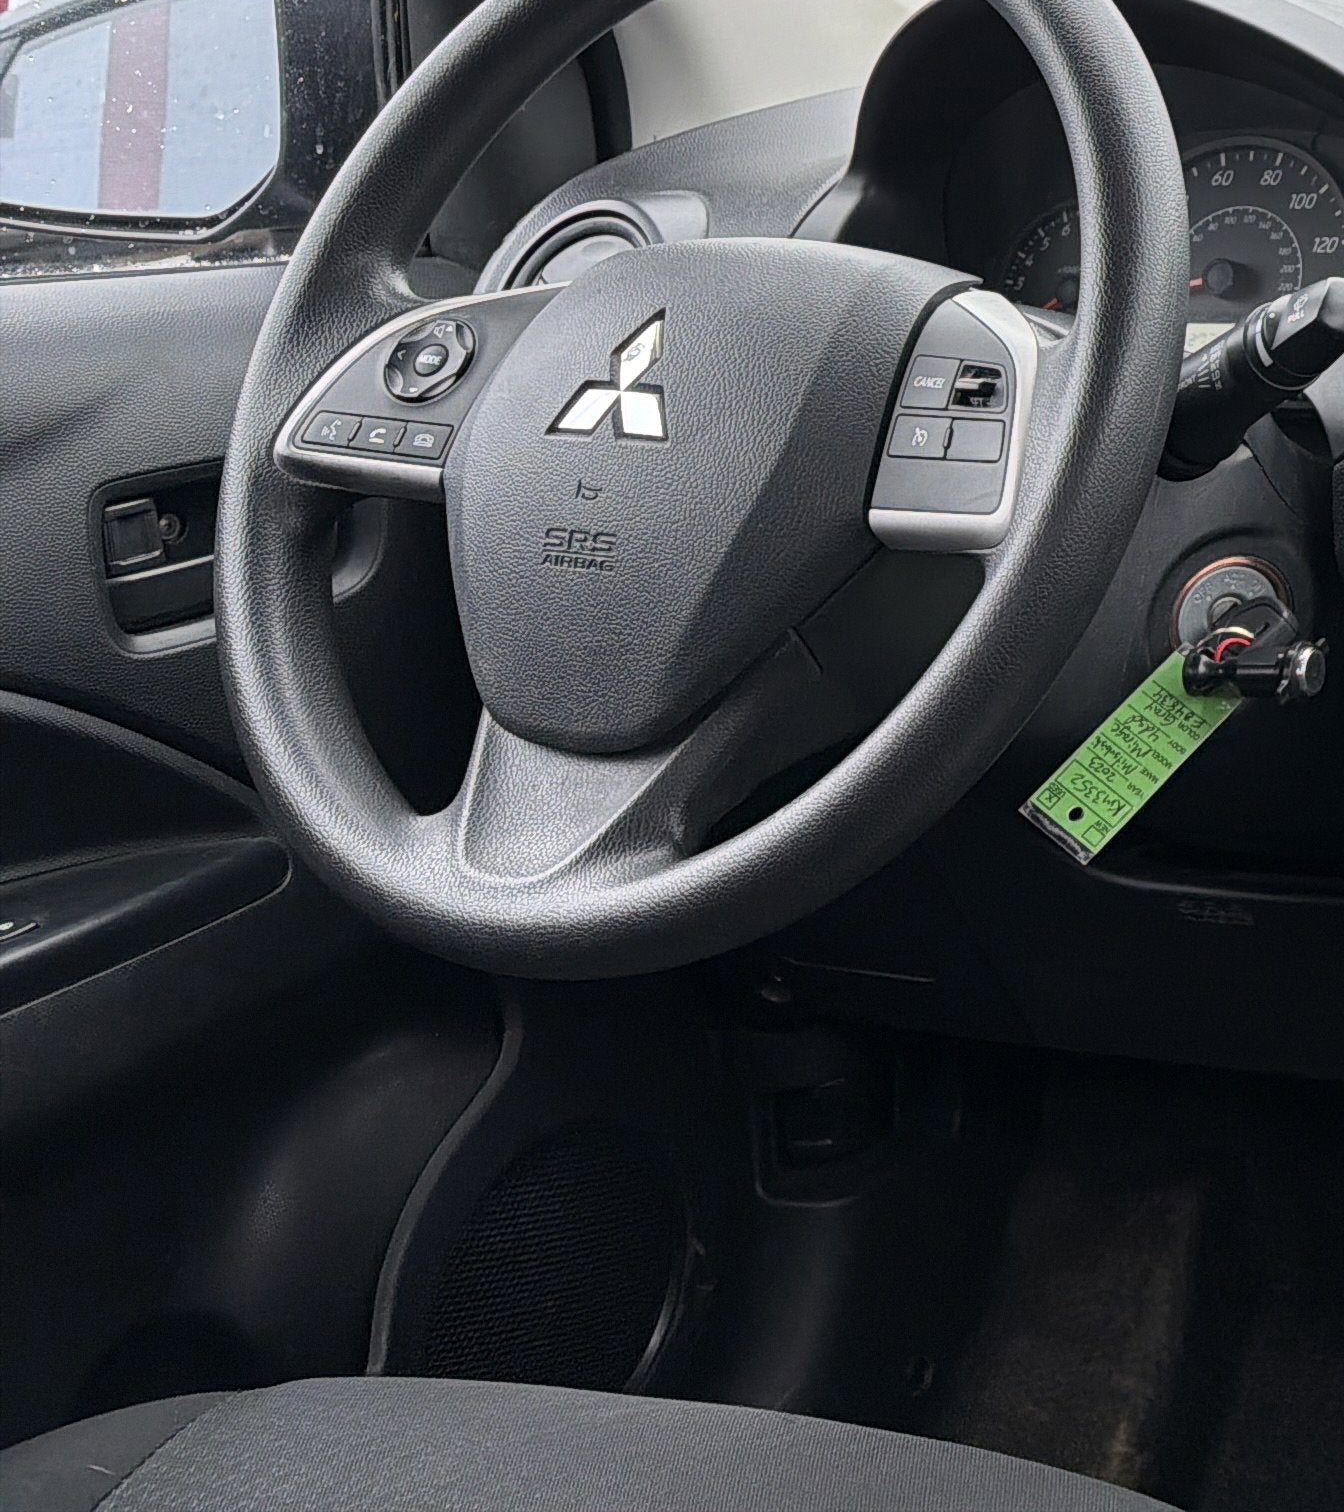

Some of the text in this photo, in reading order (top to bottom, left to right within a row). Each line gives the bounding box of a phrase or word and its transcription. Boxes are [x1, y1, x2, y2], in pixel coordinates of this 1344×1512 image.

[1211, 170, 1235, 186] 60
[1260, 170, 1284, 186] 80
[1289, 193, 1318, 210] 100
[1061, 225, 1071, 237] 6
[1312, 236, 1339, 254] 120
[913, 375, 946, 389] CANCEL
[542, 527, 618, 552] SRS
[540, 553, 617, 572] AIRBAG
[1087, 755, 1147, 800] YEAR 2023
